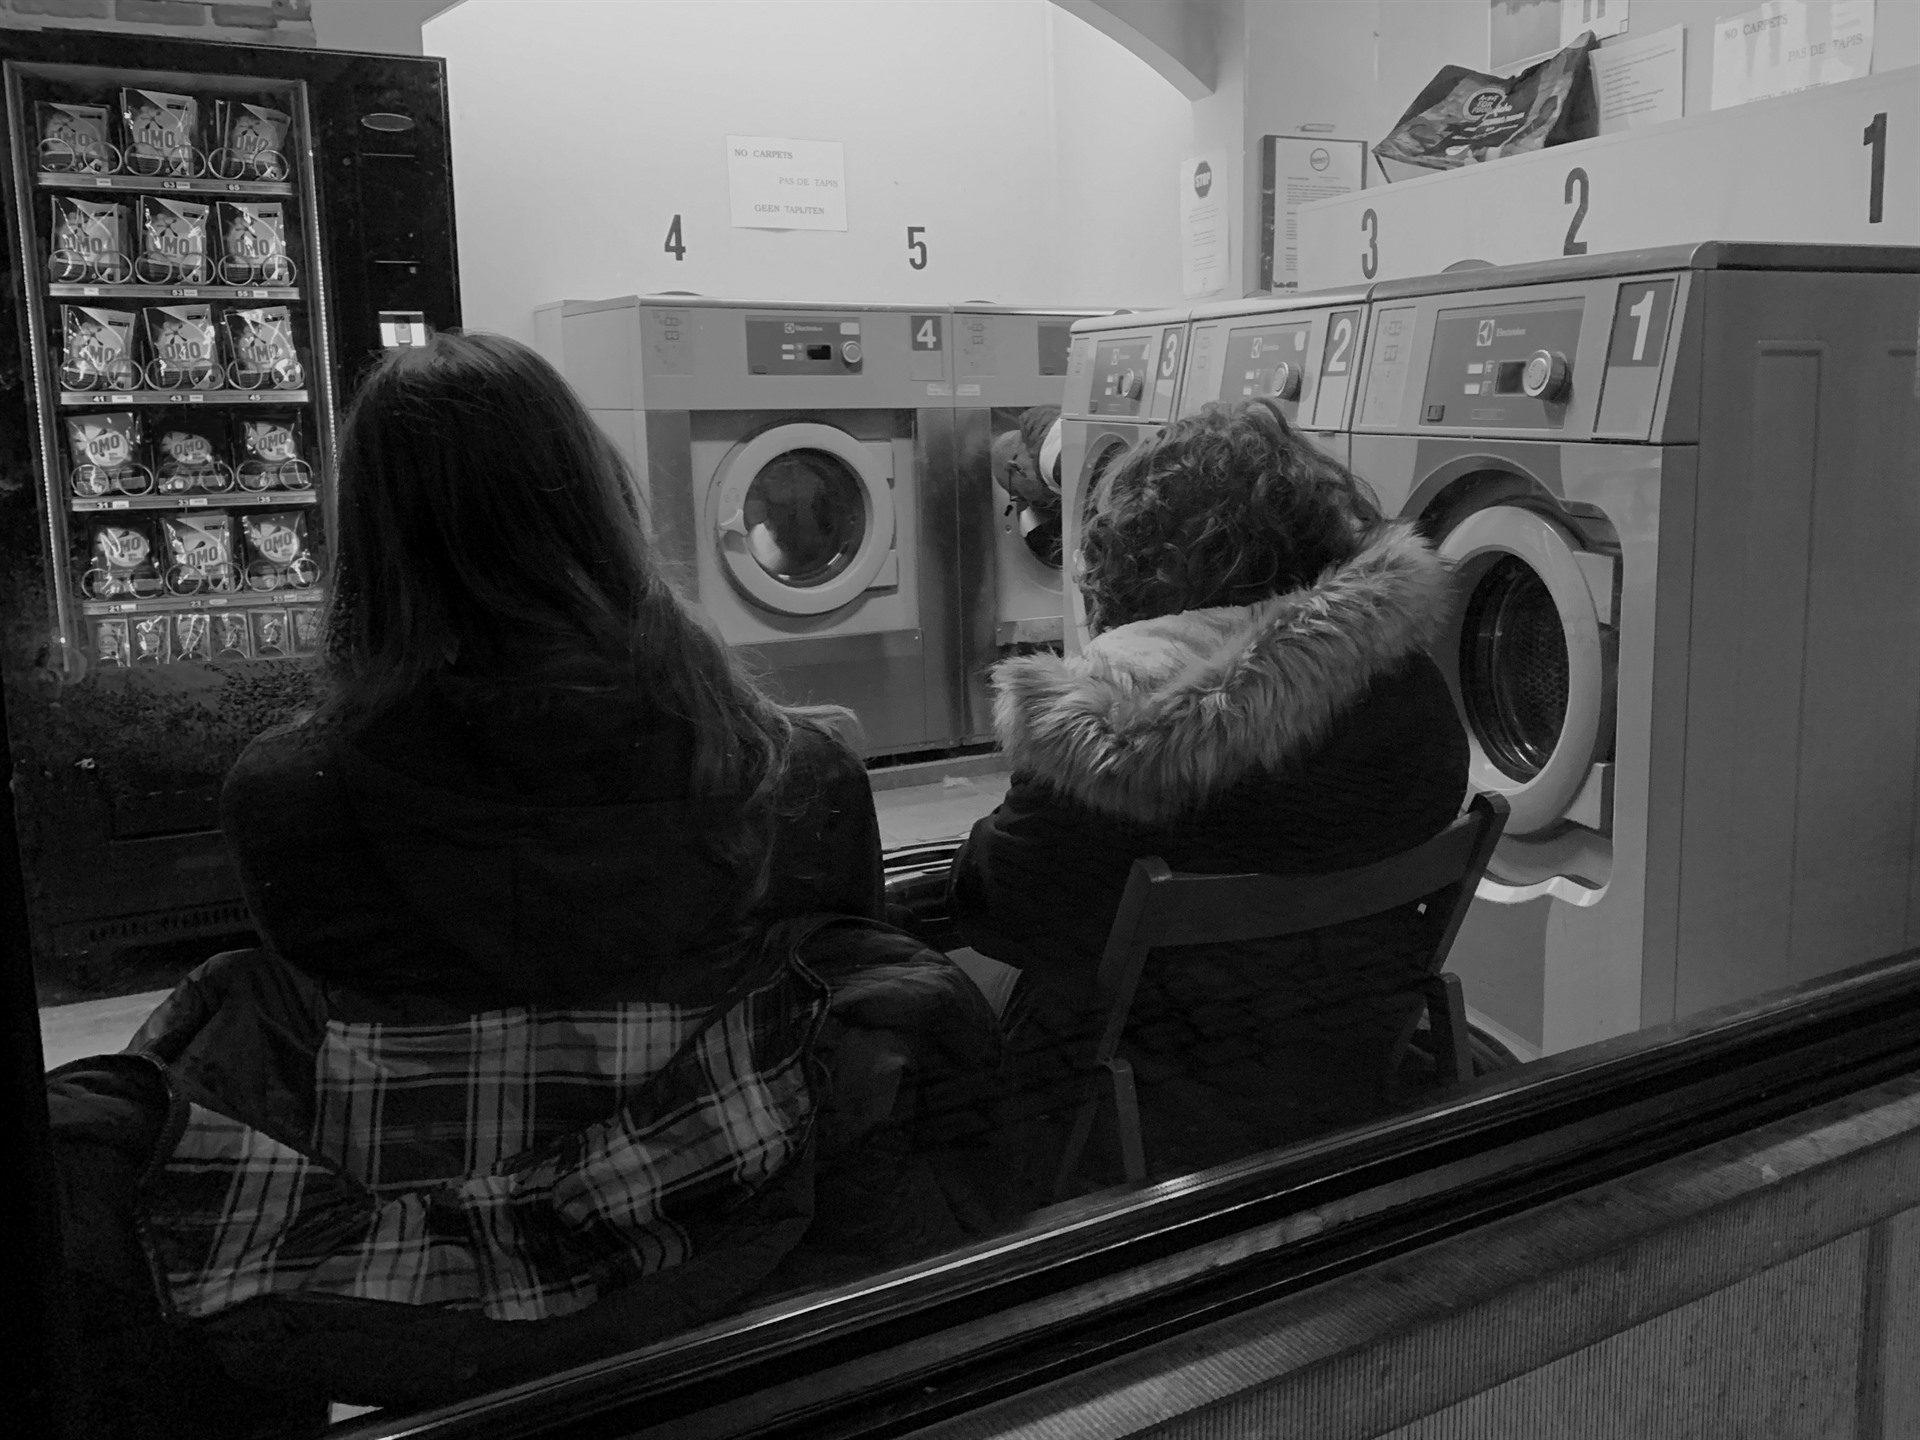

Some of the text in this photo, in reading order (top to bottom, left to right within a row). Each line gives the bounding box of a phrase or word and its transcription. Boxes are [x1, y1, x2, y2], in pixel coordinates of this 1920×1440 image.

[1724, 14, 1788, 40] NO CARPETS
[1810, 42, 1827, 56] DE
[1833, 33, 1863, 50] TAPIS
[50, 131, 89, 147] OMO
[139, 129, 175, 149] OMO
[234, 133, 269, 152] OMO
[734, 148, 793, 160] NO CARPETS
[1862, 112, 1888, 224] 1
[163, 181, 175, 189] 63
[228, 183, 240, 191] 65
[779, 176, 839, 188] PAS DE TAPIS
[1195, 171, 1211, 188] STOP
[754, 204, 825, 216] GEEN TAPIJTEN
[1563, 167, 1590, 256] 2
[65, 232, 103, 254] OMO
[235, 238, 270, 257] OMO
[664, 214, 687, 261] 4
[1361, 208, 1379, 280] 3
[907, 226, 928, 270] 5
[171, 289, 183, 297] 53
[236, 290, 248, 298] 55
[916, 320, 937, 349] 4
[1630, 290, 1655, 361] 1
[165, 342, 202, 361] OMO
[246, 343, 279, 361] OMO
[1161, 333, 1178, 377] 3
[1328, 318, 1352, 372] 2
[92, 394, 104, 402] 41
[89, 434, 120, 455] OMO
[174, 438, 204, 455] OMO
[258, 431, 288, 451] OMO
[263, 531, 293, 552] OMO
[187, 546, 218, 567] OMO
